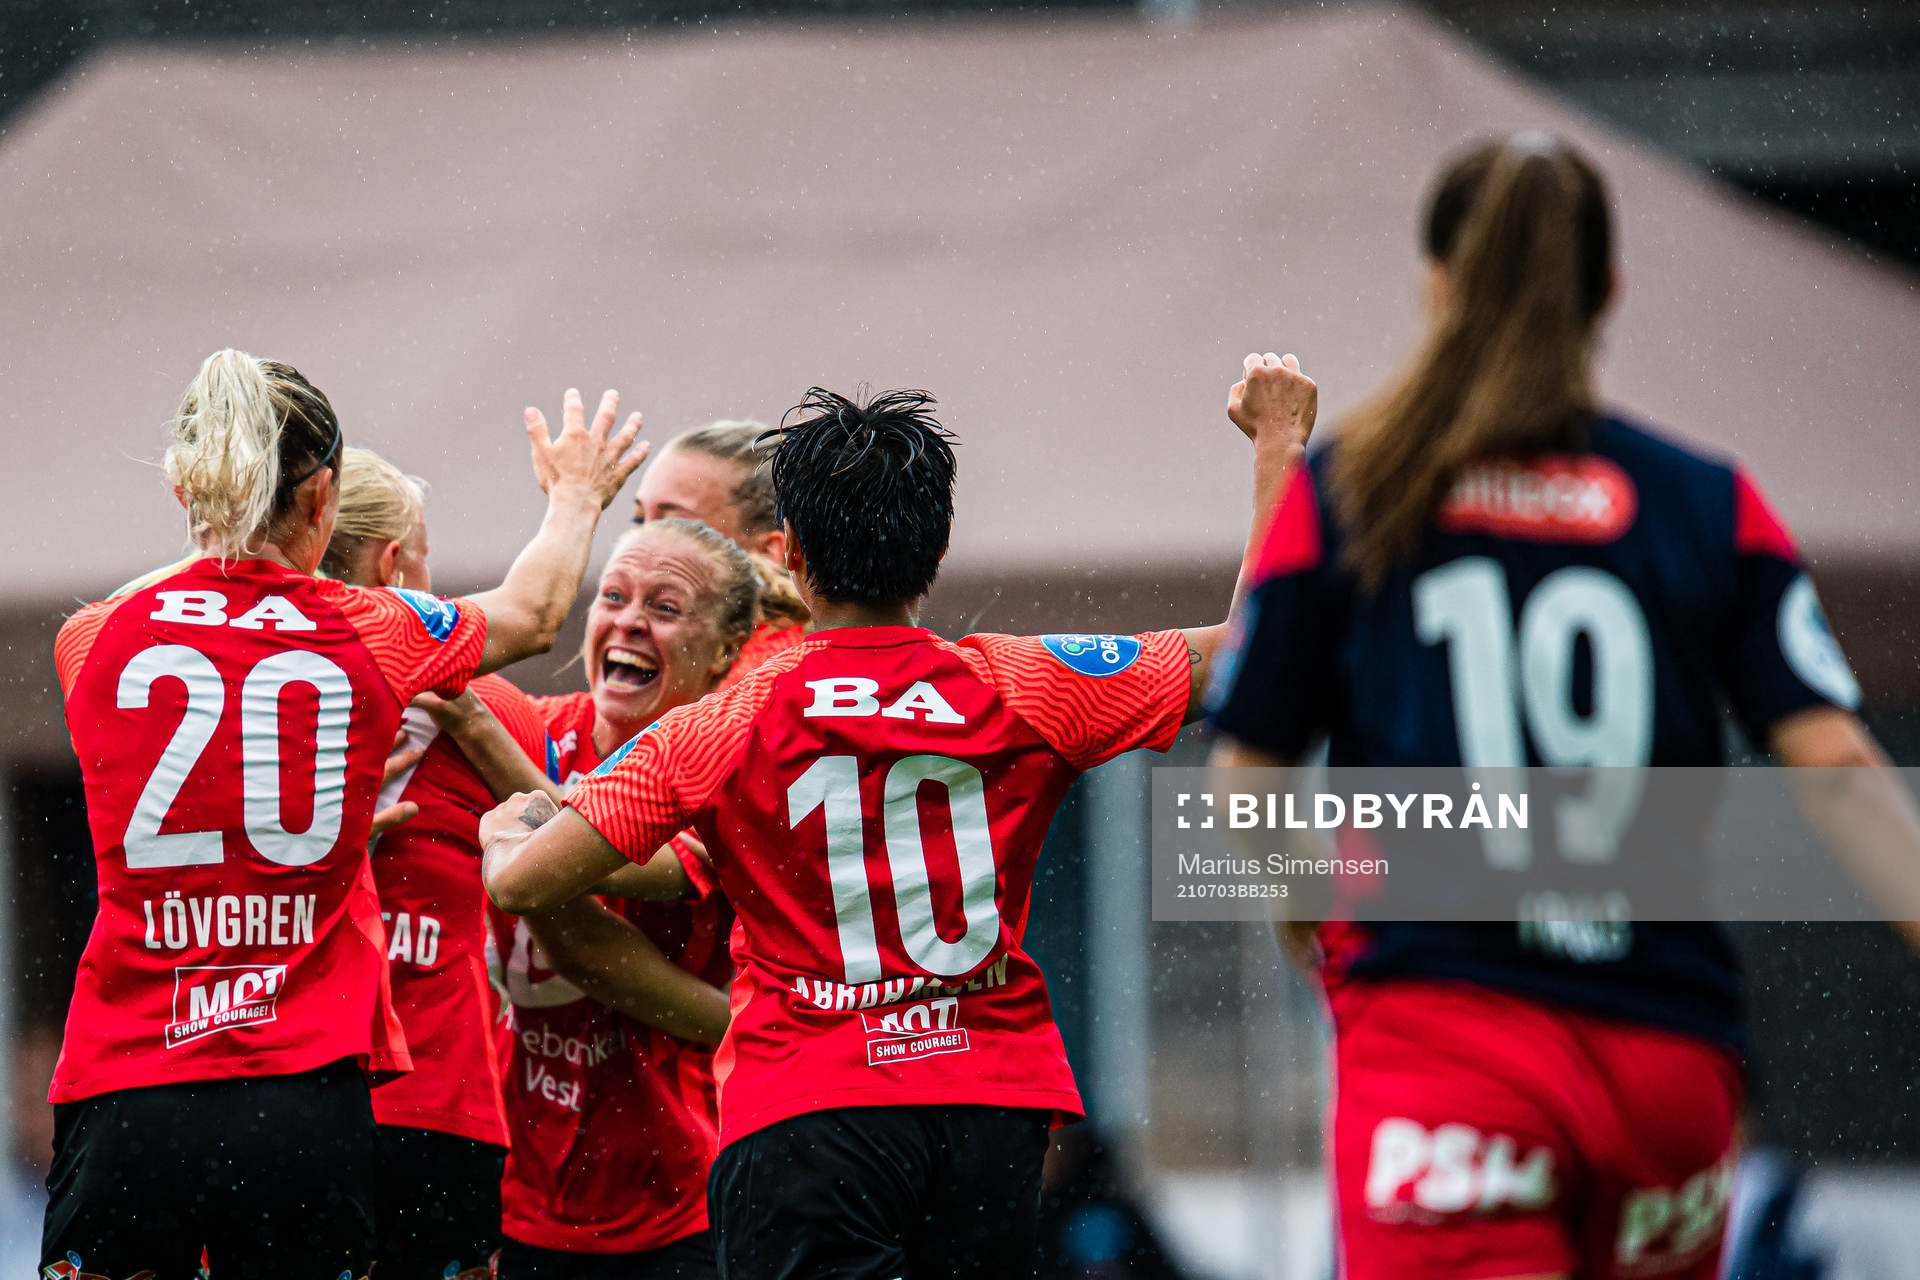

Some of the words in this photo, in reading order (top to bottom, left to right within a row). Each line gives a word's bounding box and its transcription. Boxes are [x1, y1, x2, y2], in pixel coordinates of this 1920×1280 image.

[150, 590, 317, 631] BA
[803, 677, 965, 725] BA
[1411, 556, 1654, 873] 19
[116, 643, 353, 869] 20
[787, 755, 1000, 985] 10
[143, 890, 317, 950] LÖVGREN
[381, 911, 441, 967] AD
[173, 1018, 210, 1039] SHOW
[213, 1005, 269, 1026] COURAGE!
[876, 1043, 906, 1058] SHOW
[909, 1034, 962, 1054] COURAGE!
[525, 1057, 581, 1112] Vest
